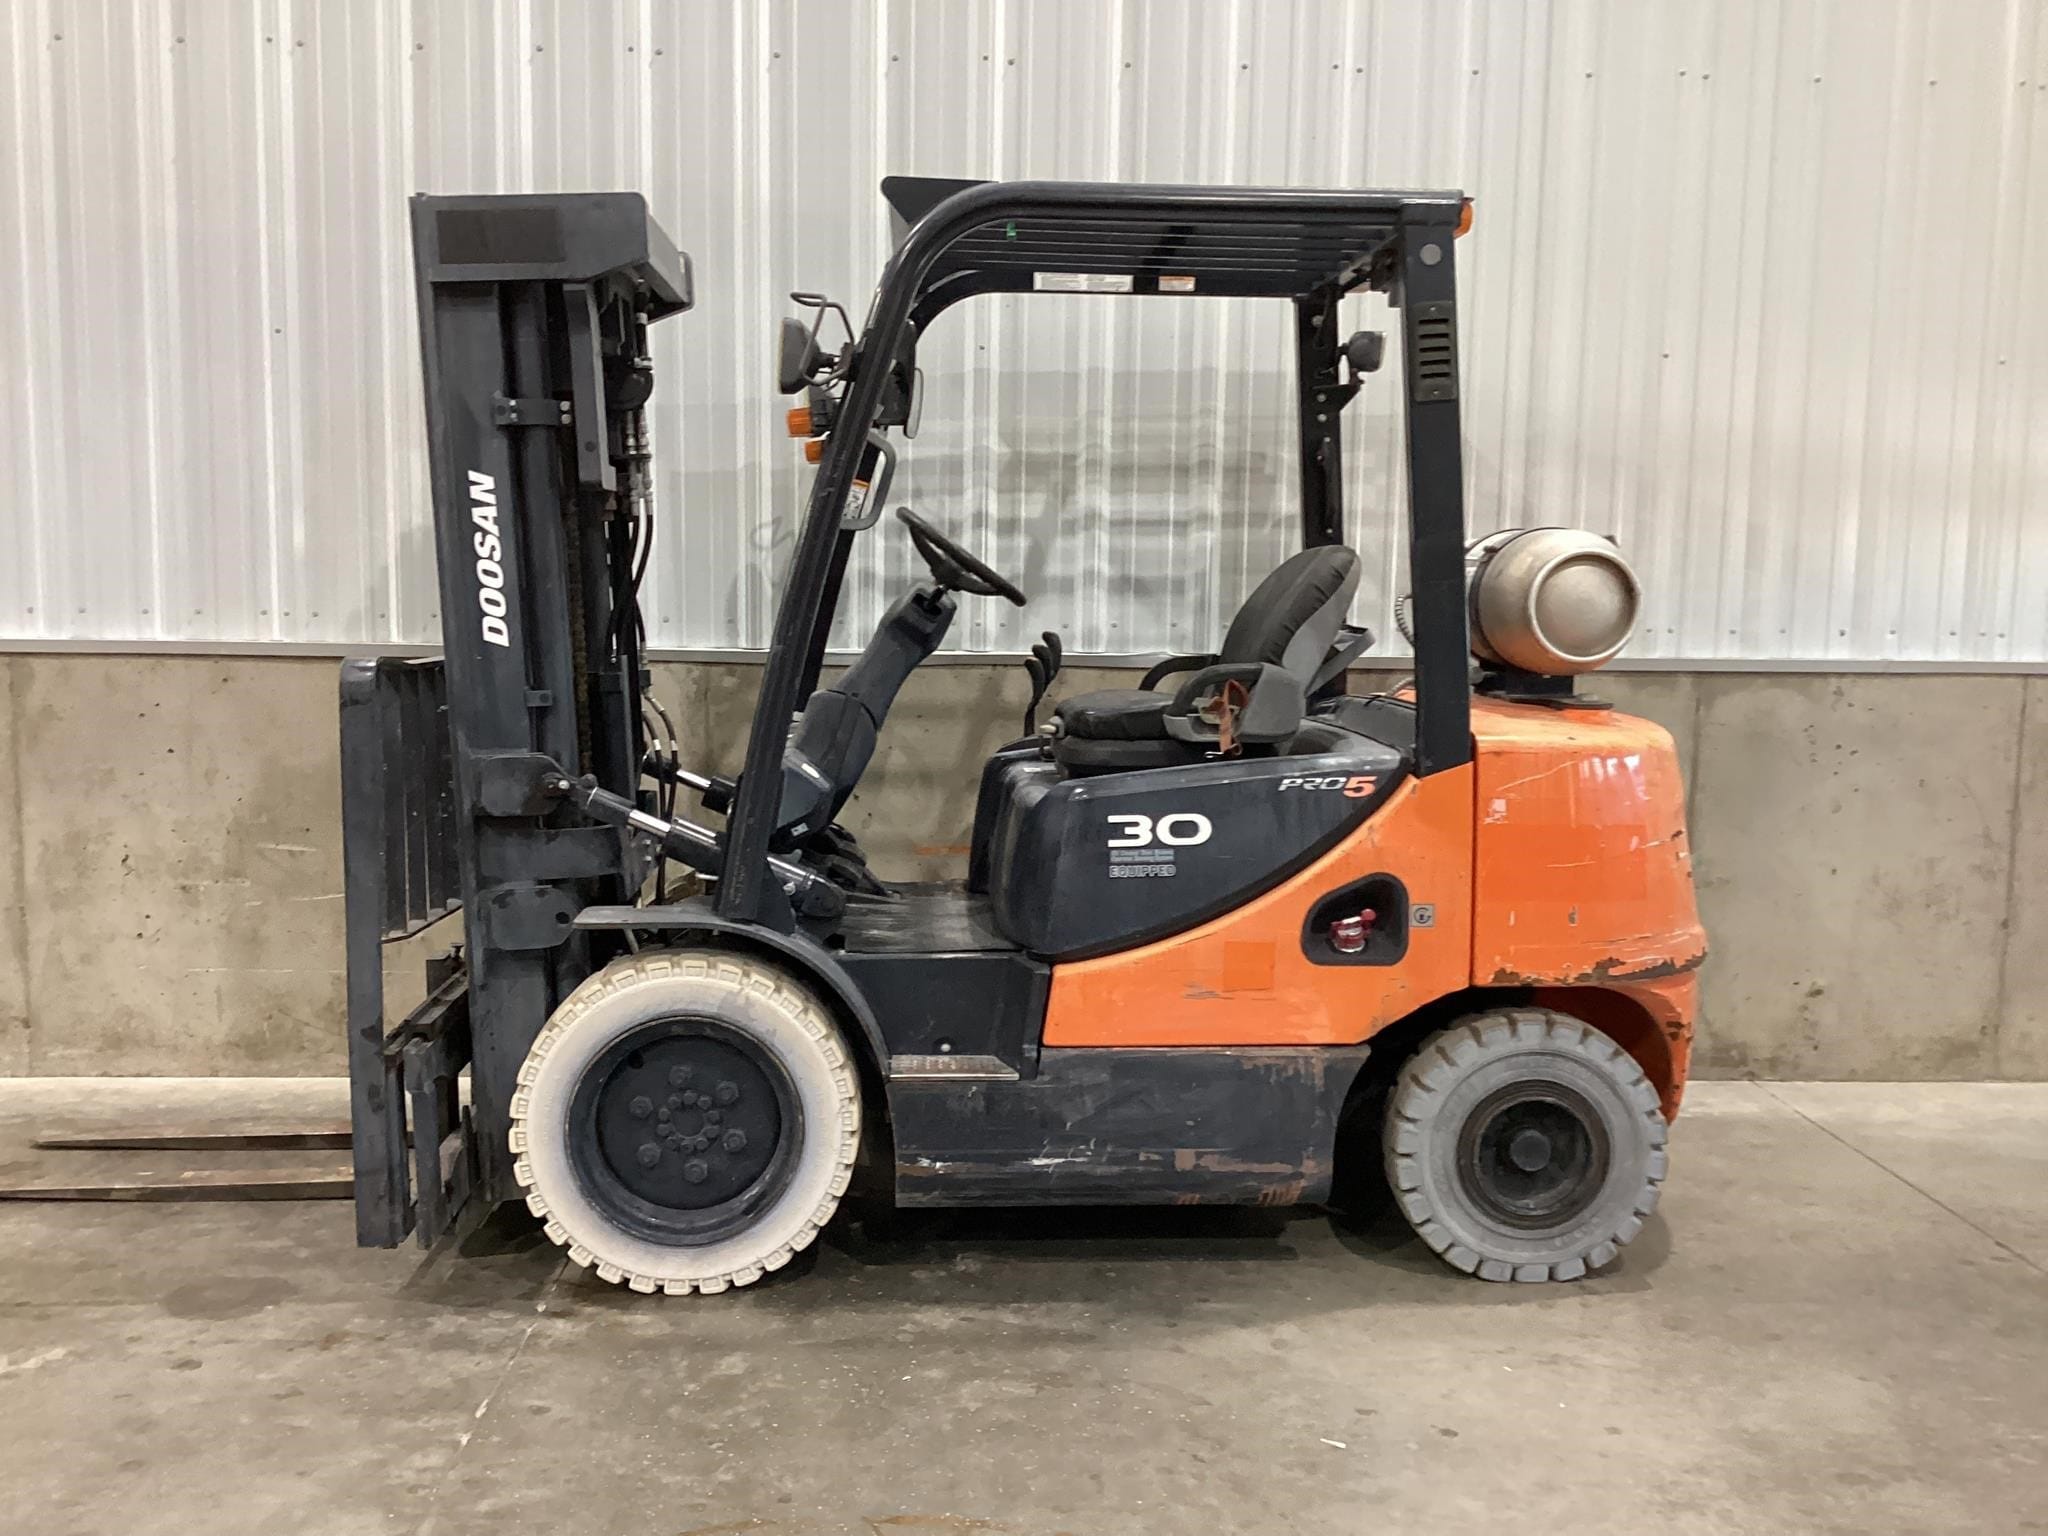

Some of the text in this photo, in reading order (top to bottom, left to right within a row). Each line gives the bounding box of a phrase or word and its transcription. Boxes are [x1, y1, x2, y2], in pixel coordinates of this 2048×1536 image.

[467, 469, 510, 647] DOOSAN
[1277, 776, 1378, 798] PRO5
[1107, 813, 1212, 847] 30
[1109, 864, 1176, 878] EQUIPPED
